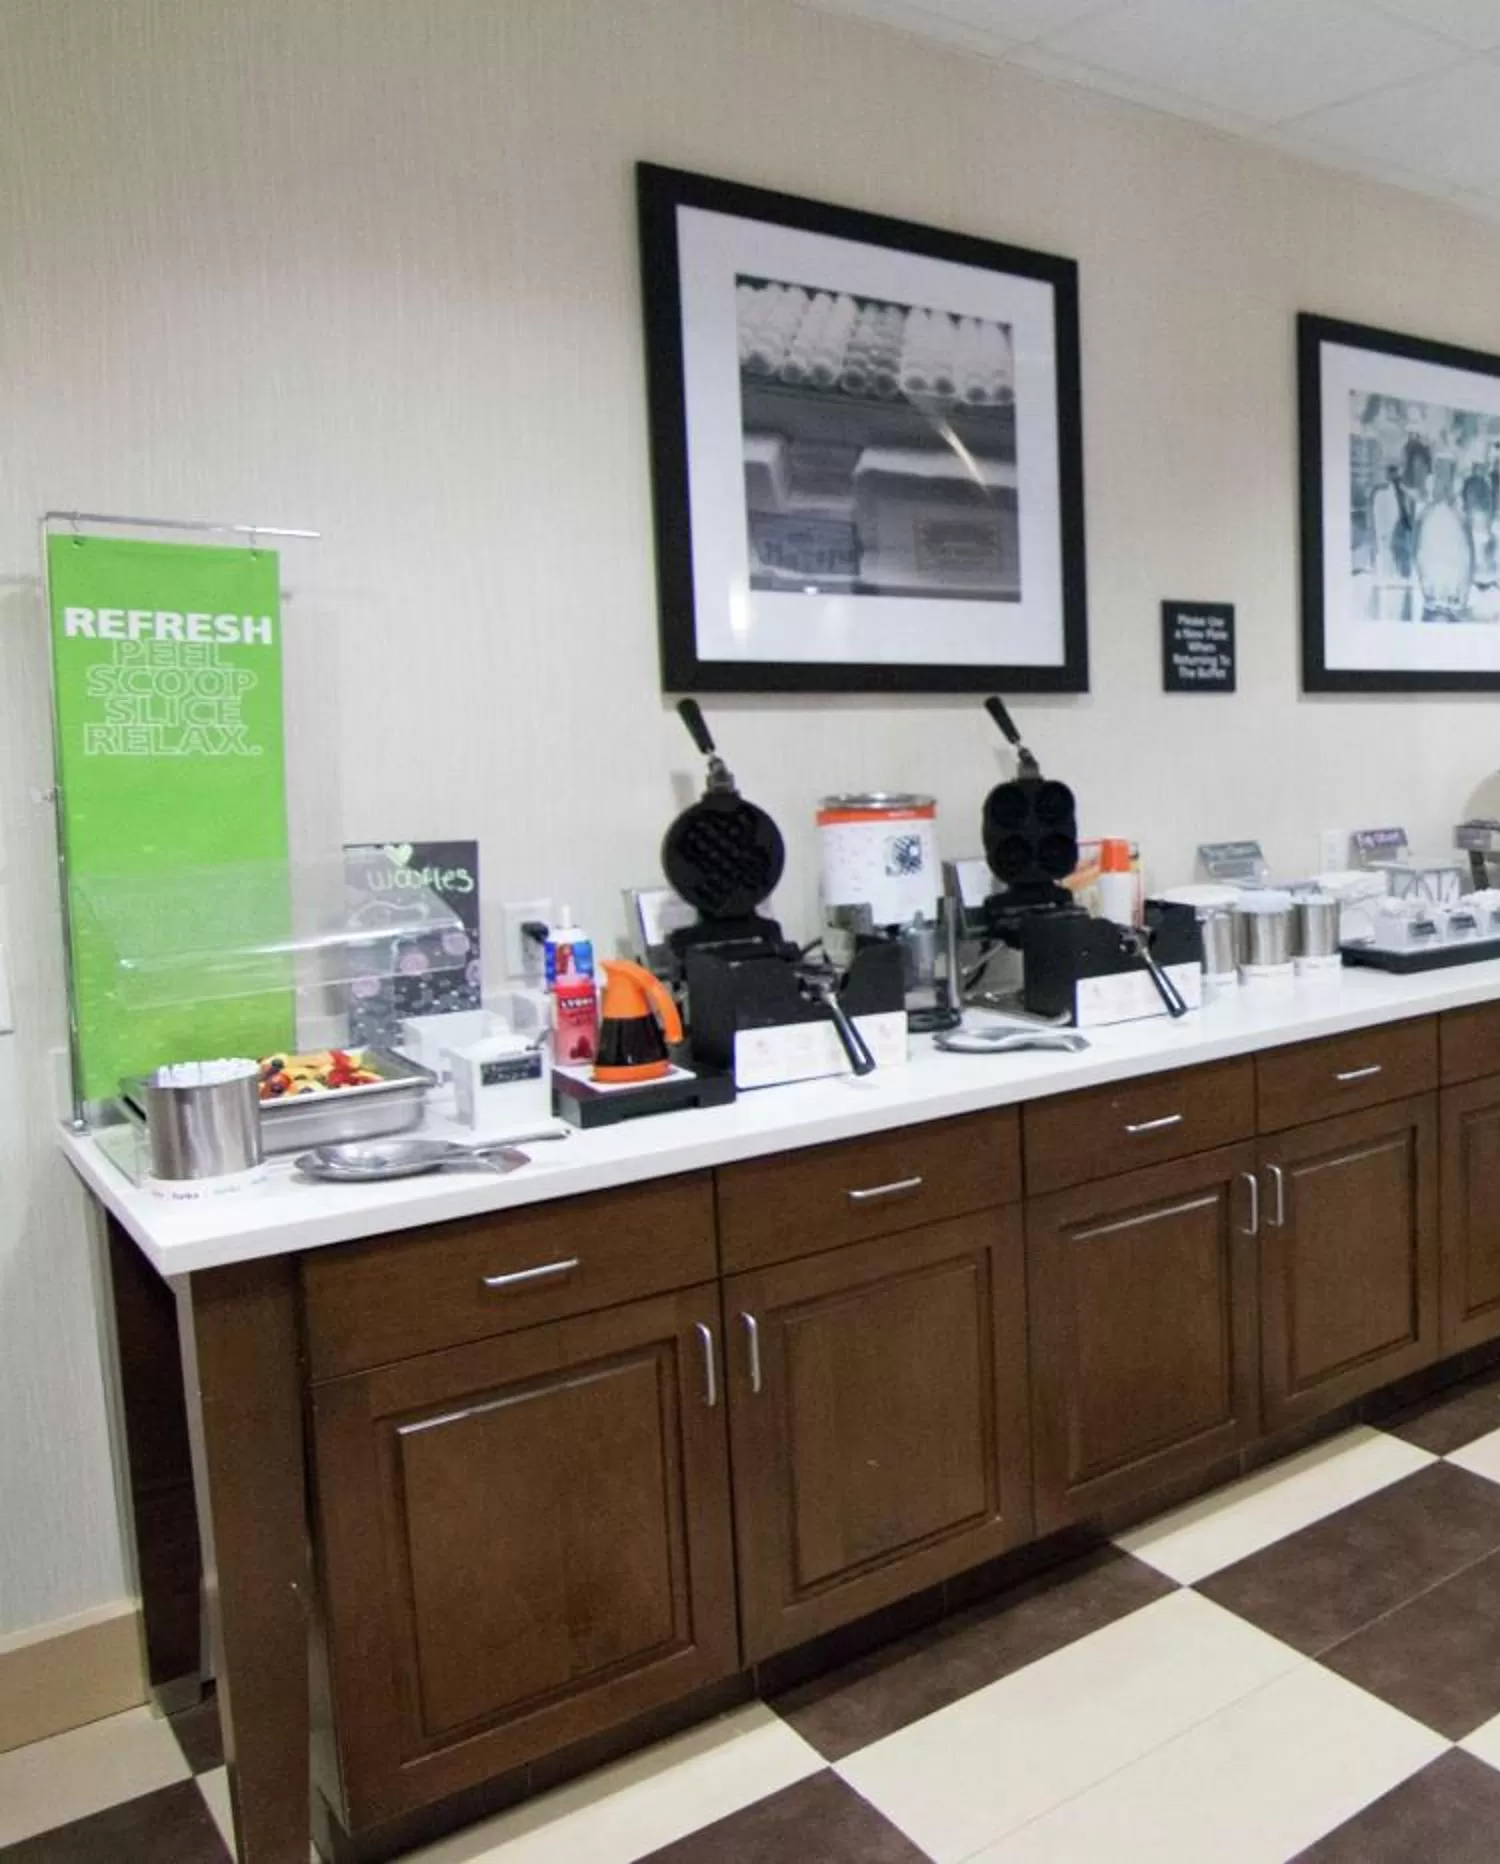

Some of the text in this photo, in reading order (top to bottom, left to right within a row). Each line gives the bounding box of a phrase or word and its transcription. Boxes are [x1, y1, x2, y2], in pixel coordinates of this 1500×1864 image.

[63, 607, 273, 645] REFRESH
[112, 638, 234, 669] PEEL
[86, 664, 259, 699] SCOOP
[104, 695, 243, 728] SLICE
[83, 721, 265, 756] RELAX.
